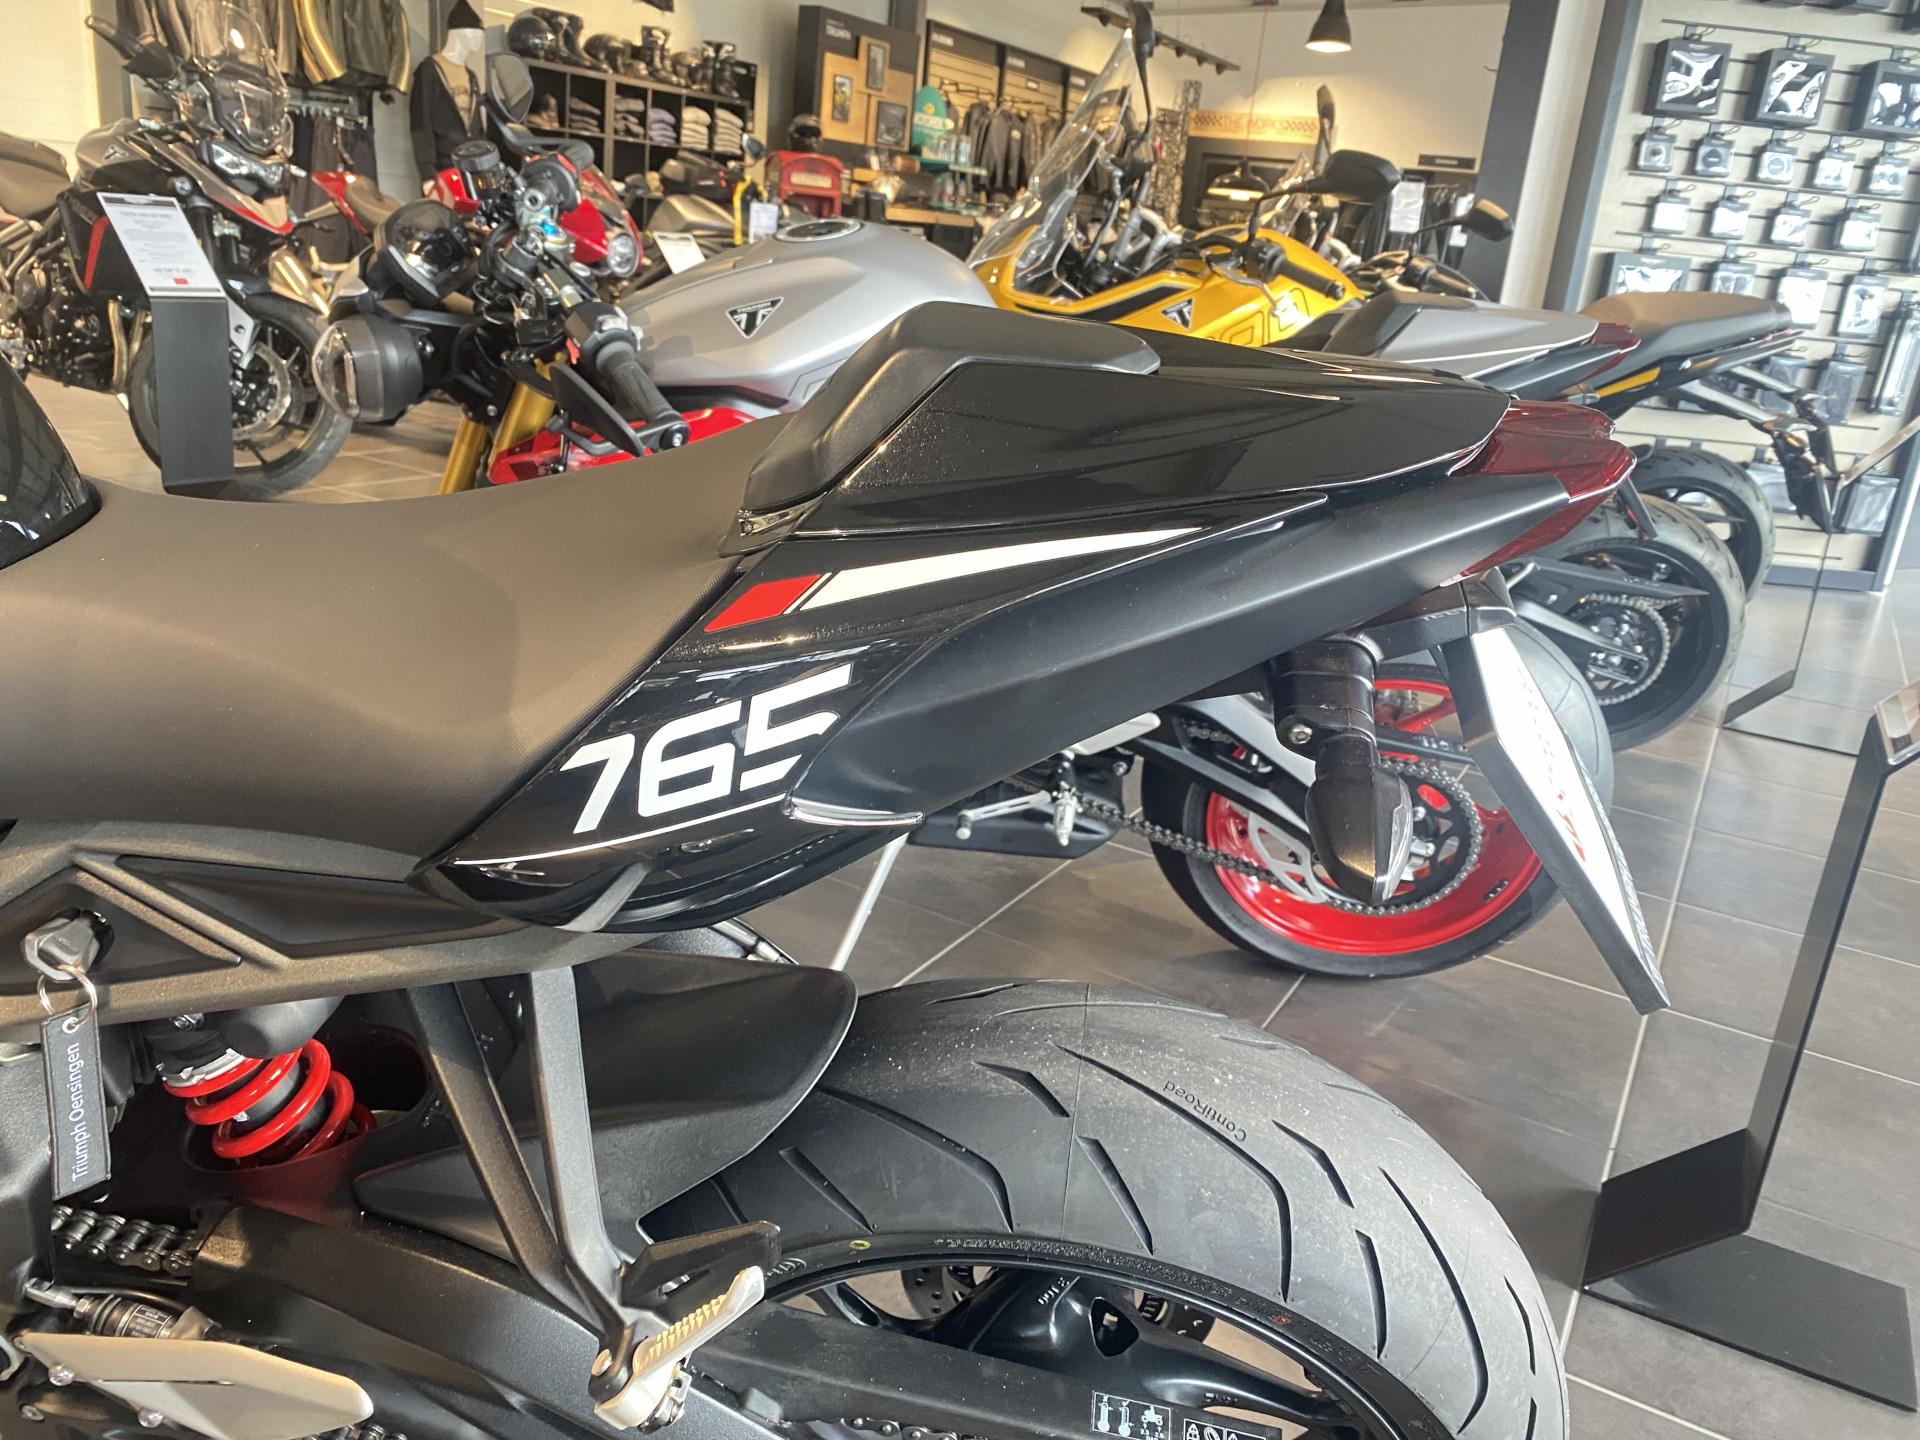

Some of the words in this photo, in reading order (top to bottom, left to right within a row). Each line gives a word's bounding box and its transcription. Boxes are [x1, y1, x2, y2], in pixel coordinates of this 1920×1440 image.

[559, 663, 852, 834] 765
[66, 1042, 85, 1122] Oensingen
[1162, 1080, 1247, 1142] ContiRoad
[70, 1121, 90, 1182] Triumph
